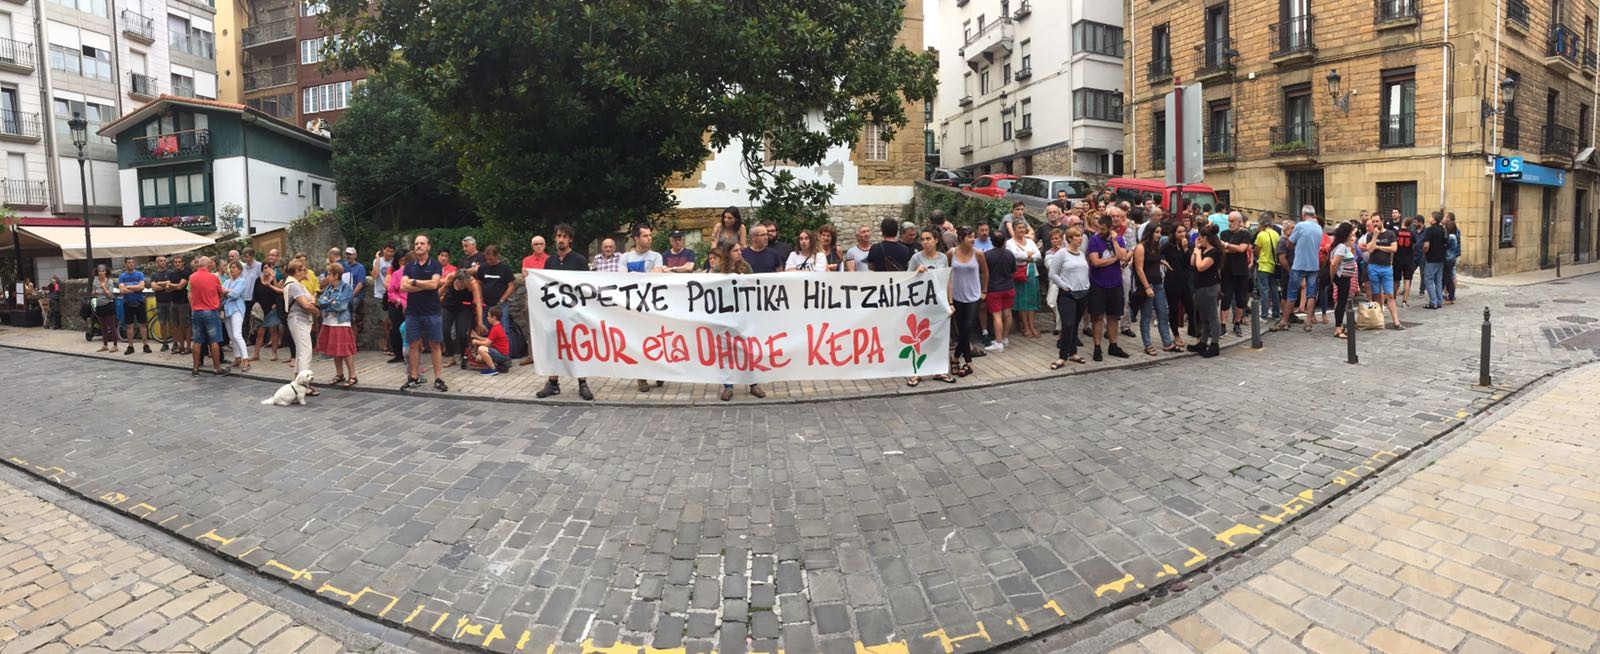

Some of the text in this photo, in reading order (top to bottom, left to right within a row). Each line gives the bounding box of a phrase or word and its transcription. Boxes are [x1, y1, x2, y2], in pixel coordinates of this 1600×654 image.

[541, 281, 668, 312] ESPETXE
[556, 319, 885, 373] AGUR eta OHORE KEPA
